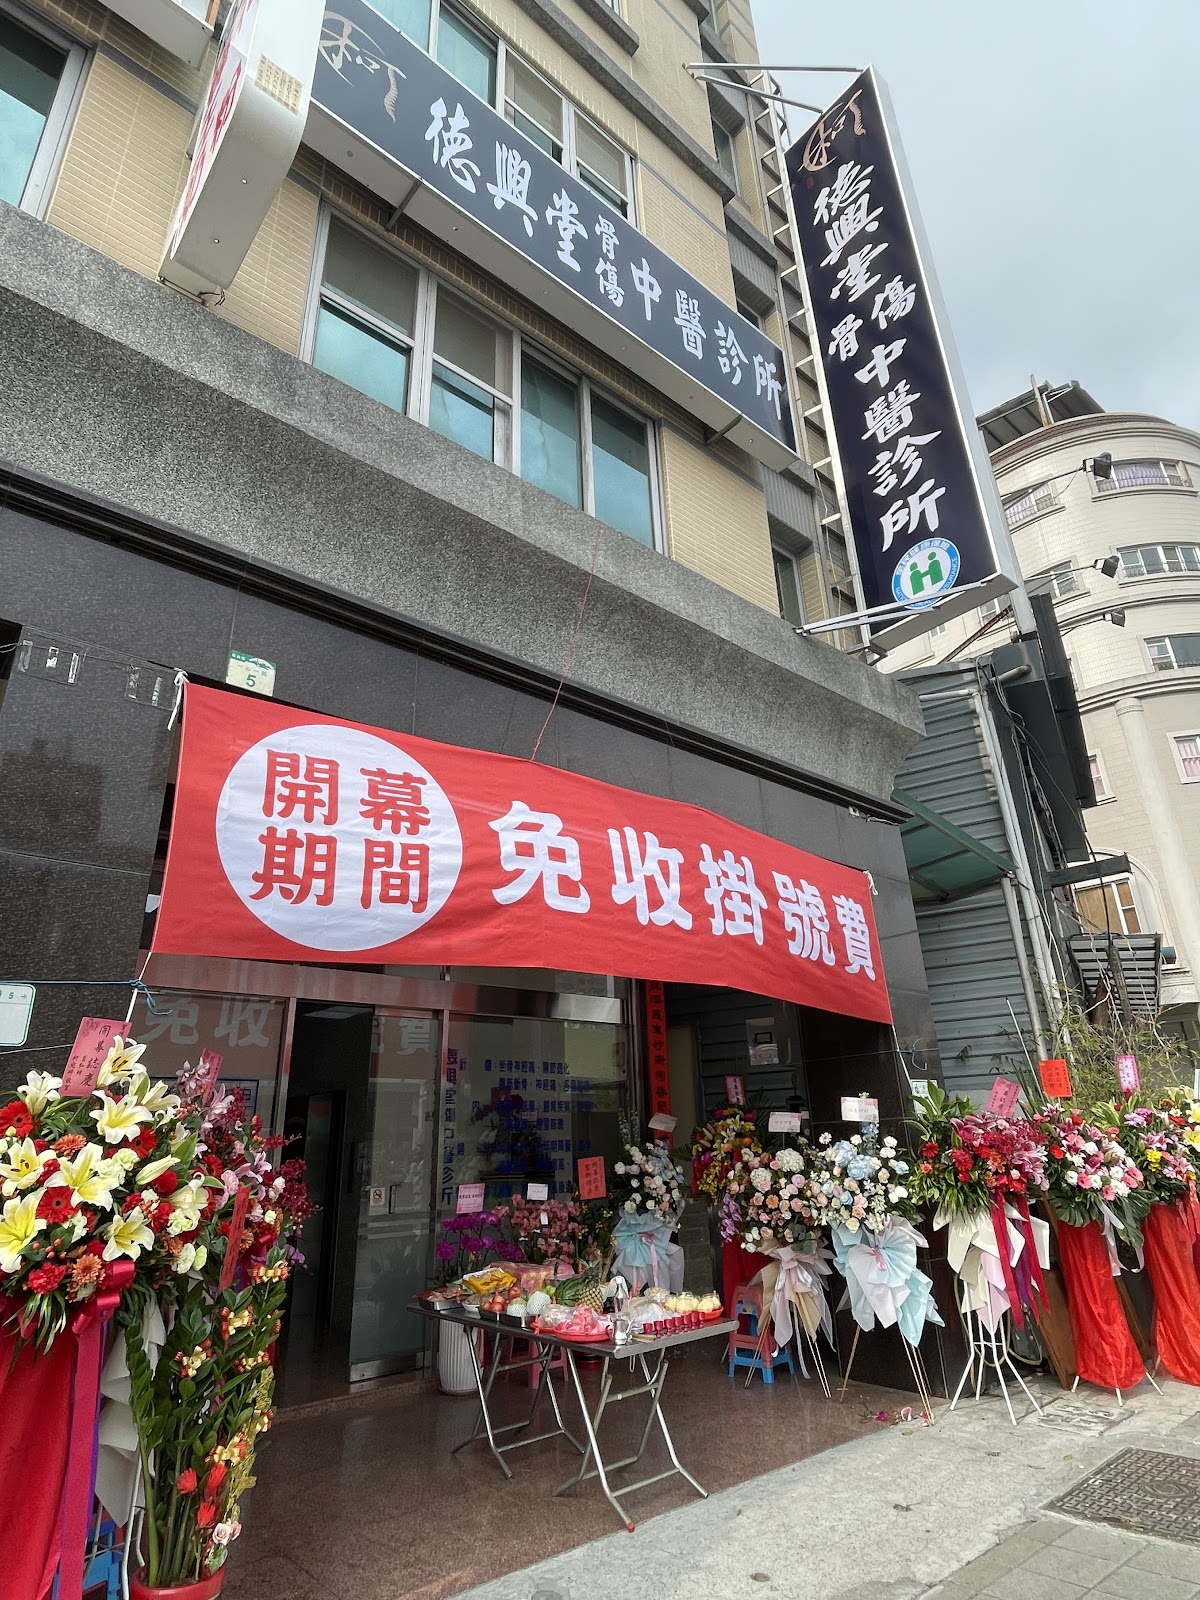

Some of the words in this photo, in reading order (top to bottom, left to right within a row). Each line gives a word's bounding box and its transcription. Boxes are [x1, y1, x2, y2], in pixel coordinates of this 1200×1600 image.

[425, 97, 588, 272] 德興堂
[595, 215, 625, 307] 骨傷
[630, 258, 782, 420] 中醫診所
[813, 161, 889, 303] 德興堂
[853, 338, 947, 553] 中醫診所
[245, 674, 256, 687] 5
[262, 749, 431, 835] 開幕
[249, 826, 431, 913] 期間
[487, 800, 876, 981] 免收掛號費
